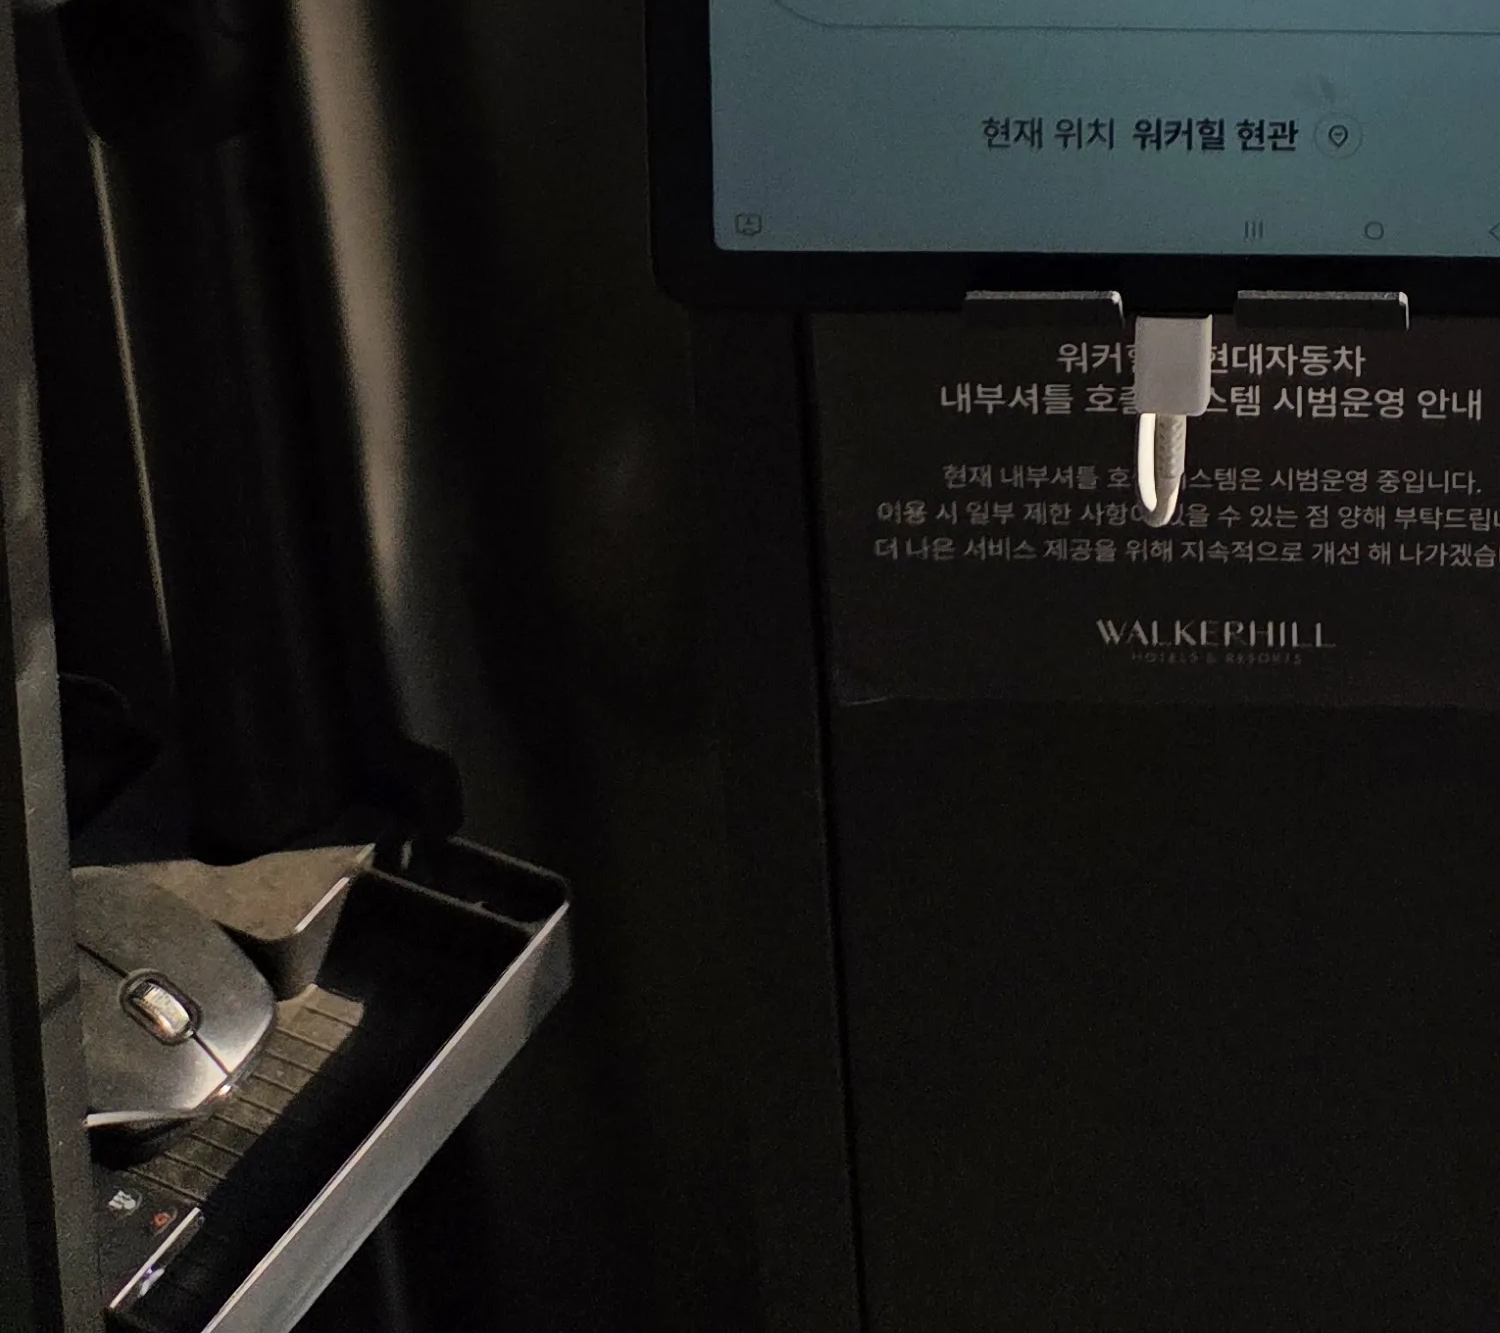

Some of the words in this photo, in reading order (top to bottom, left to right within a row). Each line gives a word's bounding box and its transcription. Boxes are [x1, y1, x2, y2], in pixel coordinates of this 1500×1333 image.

[981, 117, 1044, 150] 현재
[1055, 118, 1115, 151] 위치
[1131, 118, 1226, 153] 워커힐
[1236, 119, 1299, 153] 현관
[940, 383, 1076, 415] 내부셔틀
[1273, 386, 1404, 420] 시범운영
[1417, 388, 1483, 422] 안내
[942, 464, 992, 490] 현재
[999, 465, 1098, 491] 내부셔틀
[1269, 467, 1369, 494] 시범운영
[1377, 468, 1482, 496] 중입니다.
[877, 501, 926, 526] 이용
[937, 502, 958, 526] 시
[966, 502, 1015, 527] 일부
[1023, 502, 1072, 528] 제한
[1217, 504, 1241, 529] 수
[1249, 504, 1299, 529] 있는
[1307, 505, 1331, 530] 점
[1339, 505, 1387, 531] 양해
[874, 539, 899, 562] 더
[905, 539, 955, 562] 나은
[964, 540, 1036, 563] 서비스
[1043, 540, 1116, 565] 제공을
[1126, 541, 1173, 566] 위해
[1182, 540, 1303, 567] 지속적으로
[1311, 542, 1360, 568] 개선
[1368, 543, 1392, 568] 해
[1096, 619, 1336, 649] WALKERHILL
